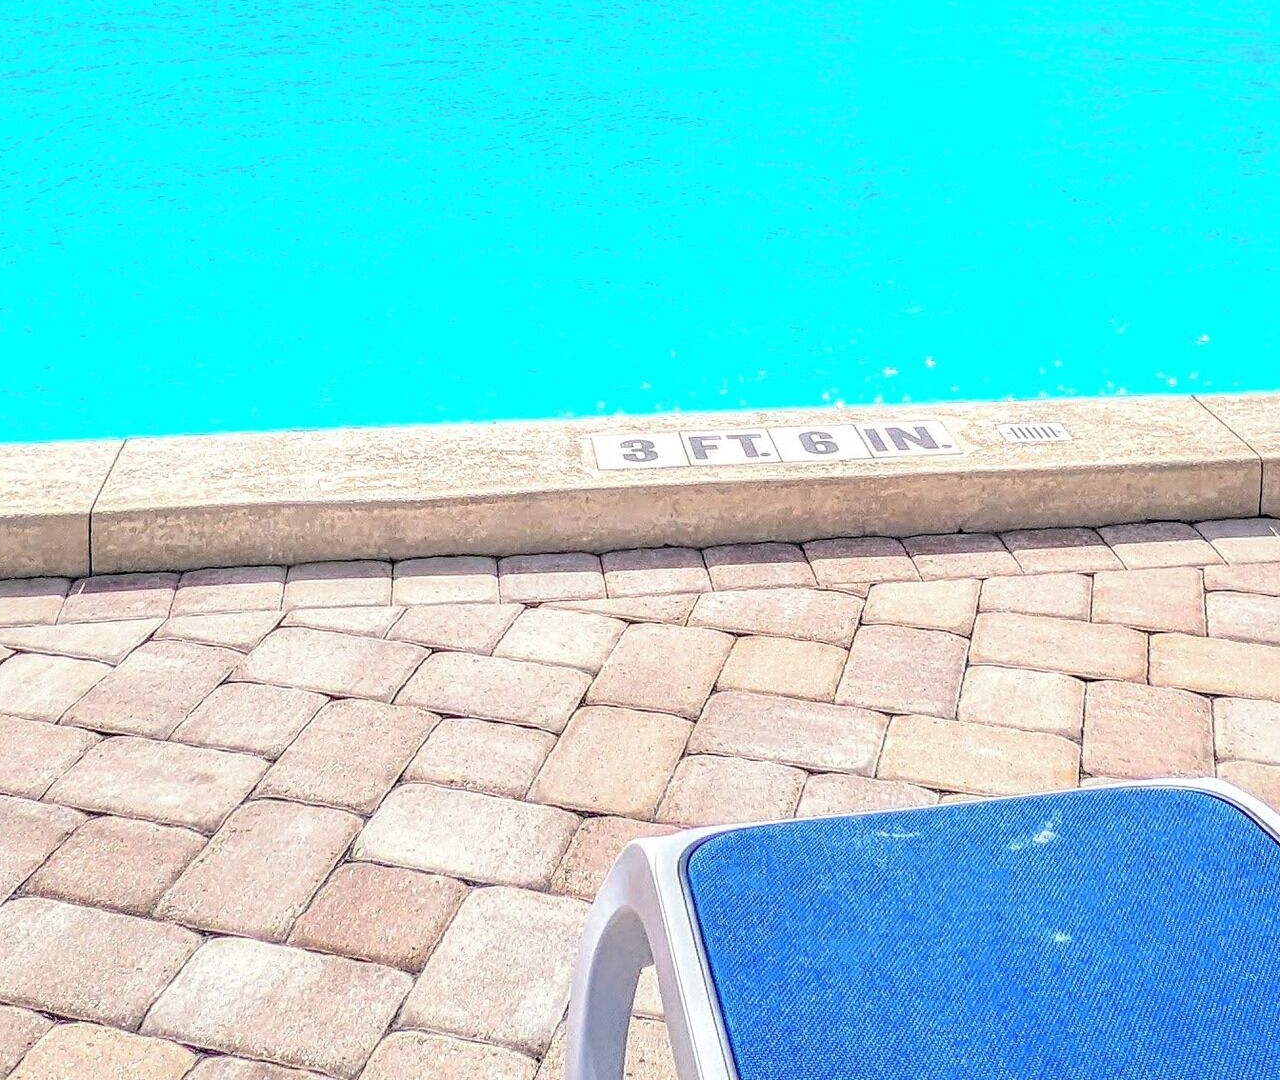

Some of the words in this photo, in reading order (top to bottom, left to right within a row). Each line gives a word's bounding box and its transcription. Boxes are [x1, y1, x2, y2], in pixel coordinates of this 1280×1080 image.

[620, 439, 659, 463] 3
[688, 433, 771, 460] FT.
[798, 431, 840, 455] 6
[863, 426, 953, 452] IN.
